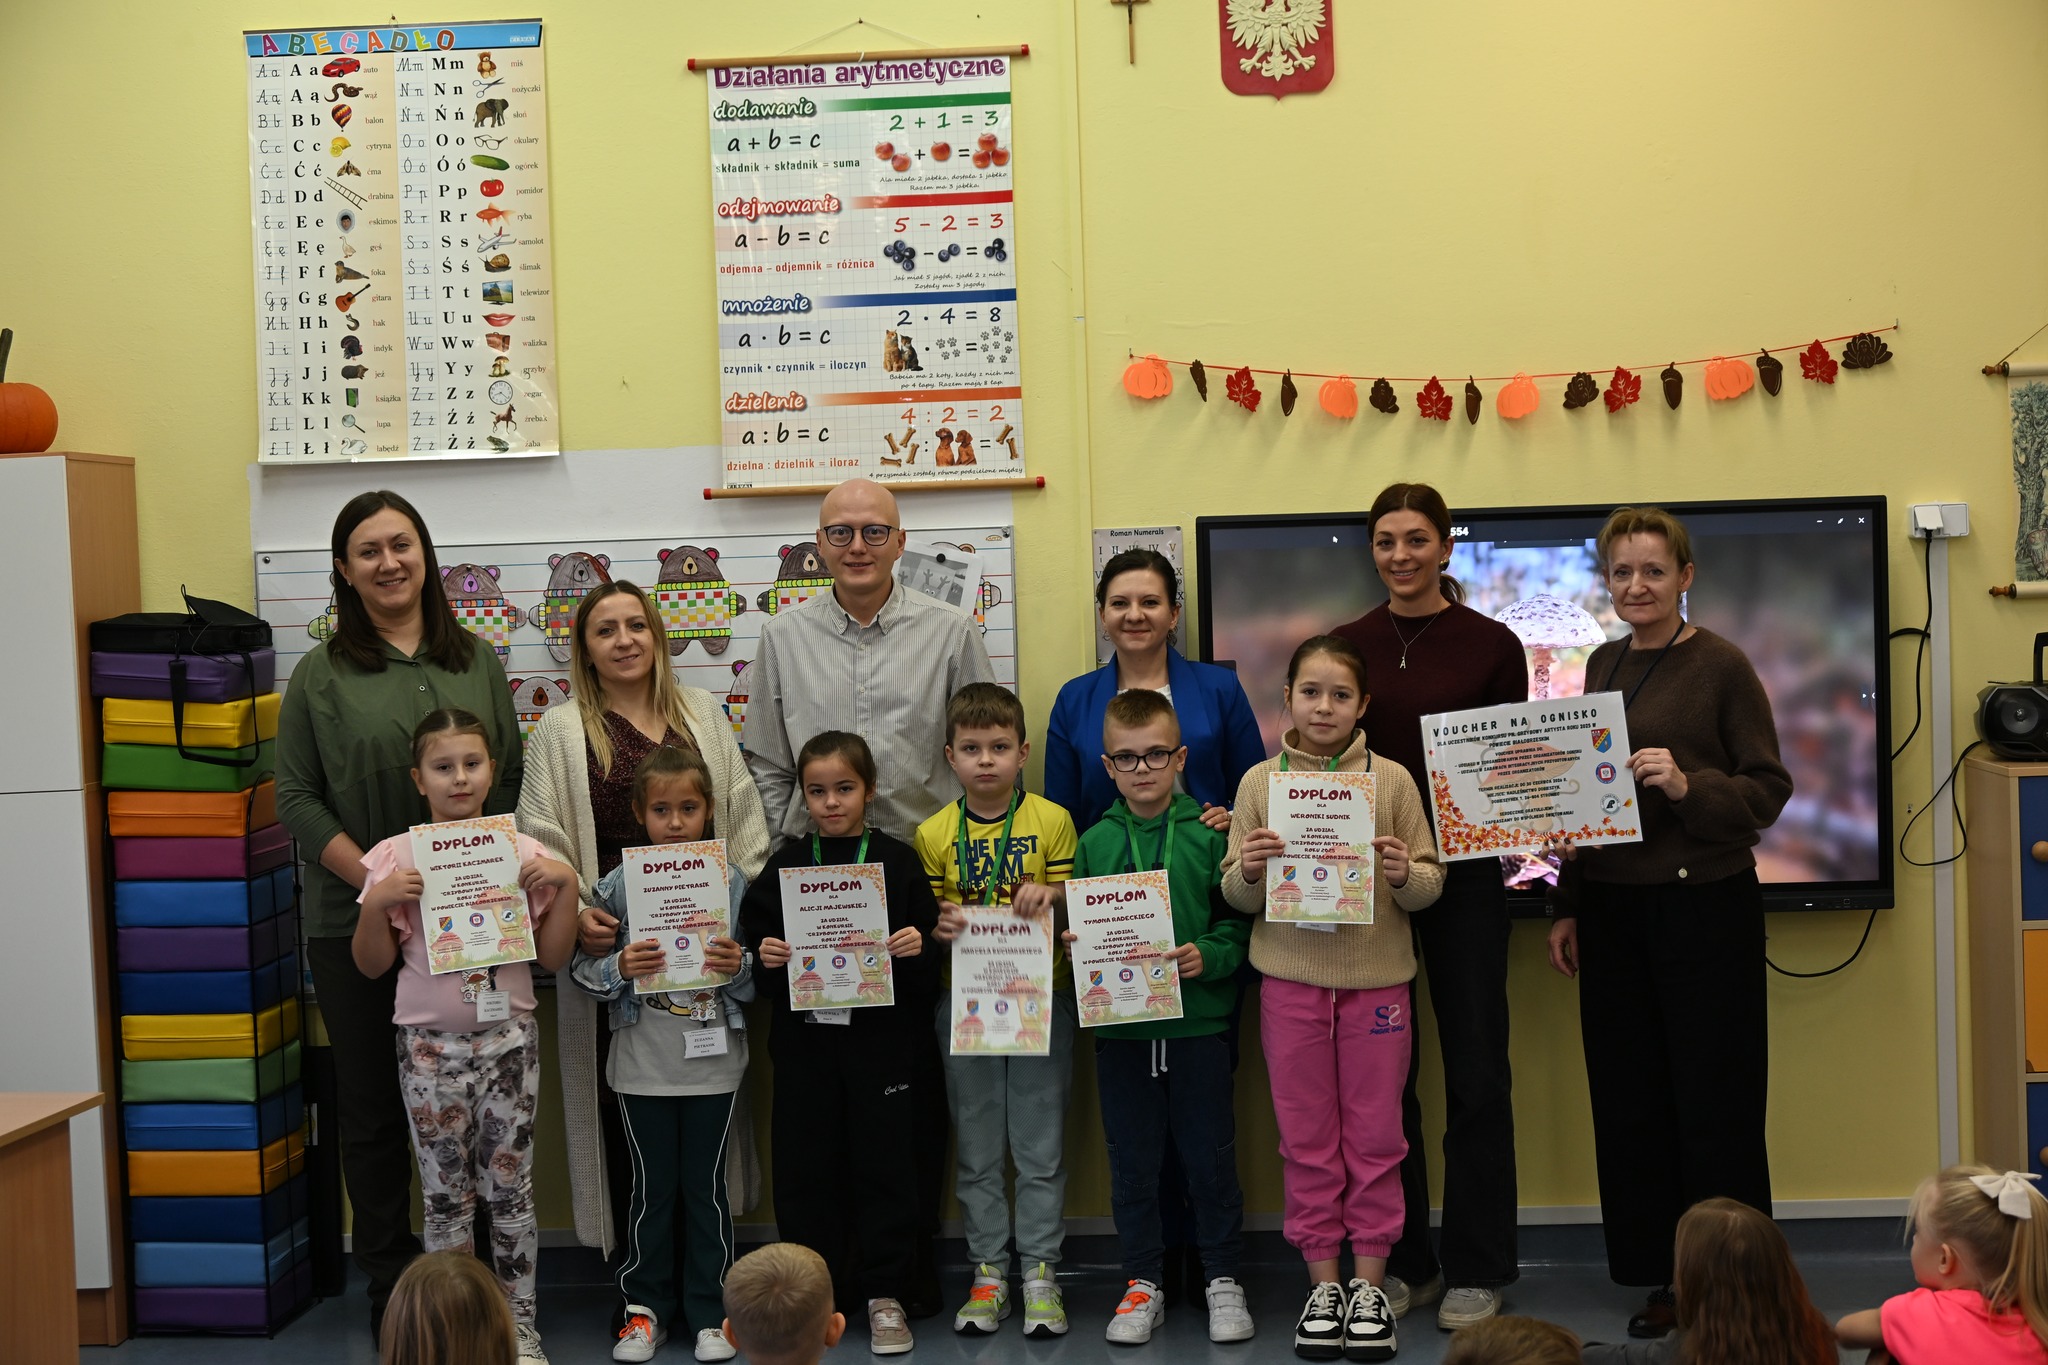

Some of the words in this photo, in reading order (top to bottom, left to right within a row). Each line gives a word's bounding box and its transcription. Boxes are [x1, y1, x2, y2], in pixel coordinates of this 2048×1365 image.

[261, 30, 456, 56] ABECADŁO
[510, 59, 524, 67] miś
[363, 66, 379, 74] auto
[714, 62, 825, 88] Działania
[836, 58, 1006, 87] arytmetyczne
[511, 84, 541, 95] nożyczki
[715, 97, 814, 119] dodawanie
[512, 110, 528, 119] słoń
[365, 116, 384, 124] balon
[513, 136, 539, 145] okulary
[727, 137, 741, 152] a
[768, 128, 781, 150] b
[810, 133, 821, 149] c
[365, 143, 392, 151] cytryna
[514, 161, 539, 171] ogórek
[716, 163, 760, 173] składnik
[774, 160, 818, 171] składnik
[833, 160, 860, 168] suma
[952, 173, 976, 181] dostała
[367, 192, 395, 200] drabina
[516, 186, 544, 196] pomidor
[719, 194, 839, 221] odejmowanie
[368, 217, 398, 226] eskimos
[517, 212, 533, 222] ryba
[734, 233, 748, 248] a
[777, 224, 790, 246] b
[818, 230, 830, 245] c
[518, 237, 544, 246] samolot
[369, 243, 383, 252] gęś
[519, 262, 541, 271] ślimak
[720, 264, 763, 276] odjemna
[775, 261, 822, 274] odjemnik
[837, 259, 875, 270] różnica
[370, 268, 386, 276] foka
[520, 288, 550, 297] telewizor
[371, 295, 392, 303] gitara
[723, 295, 809, 315] mnożenie
[372, 319, 386, 327] hak
[738, 333, 752, 348] a
[778, 324, 791, 346] b
[819, 329, 831, 345] c
[522, 338, 548, 347] walizka
[373, 344, 393, 353] indyk
[522, 365, 547, 375] grzyby
[723, 364, 763, 376] czynnik
[775, 362, 815, 374] czynnik
[830, 361, 867, 371] iloczyn
[375, 394, 402, 403] książka
[523, 390, 542, 399] zegar
[726, 392, 804, 412] dzielenie
[376, 420, 392, 429] lupa
[742, 430, 755, 445] a
[776, 421, 790, 444] b
[818, 427, 830, 442] c
[726, 461, 764, 471] dzielna
[774, 459, 815, 470] dzielnik
[829, 458, 859, 468] iloraz
[1169, 543, 1176, 551] V
[1433, 721, 1498, 737] VOUCHER
[1511, 717, 1528, 727] NA
[1540, 709, 1598, 724] OGNISKO
[1448, 737, 1480, 746] UCZESTNIKÓW
[1482, 733, 1507, 741] KONKURSU
[1512, 736, 1550, 745] BIAŁOBRZESKIM
[1289, 788, 1352, 801] DYPLOM
[432, 834, 495, 852] DYPLOM
[429, 862, 462, 872] WIKTORII
[462, 856, 504, 867] KACZMAREK
[643, 858, 705, 874] DYPLOM
[674, 881, 710, 891] PIETRASIK
[800, 880, 862, 894] DYPLOM
[1086, 889, 1147, 906] DYPLOM
[823, 902, 868, 911] MAJEWSKIEJ
[1112, 913, 1155, 922] RADECKIEGO
[971, 922, 1031, 937] DYPLOM
[1088, 957, 1115, 965] POWIECIE
